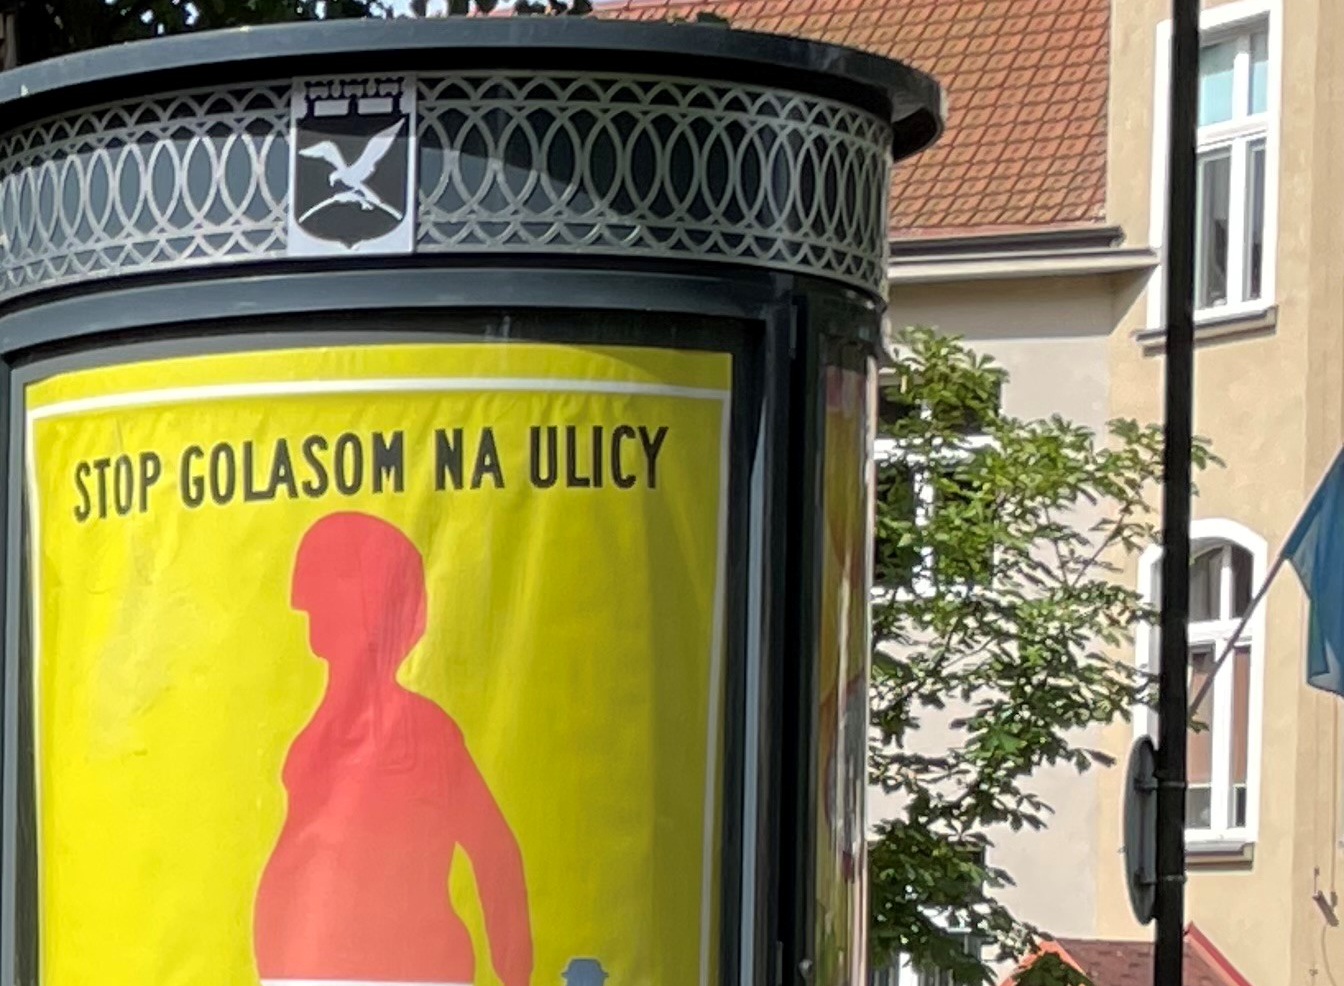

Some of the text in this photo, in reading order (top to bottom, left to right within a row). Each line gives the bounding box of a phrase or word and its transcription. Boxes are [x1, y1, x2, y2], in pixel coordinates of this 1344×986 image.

[74, 424, 670, 523] STOP GOLASOM NA ULICY
